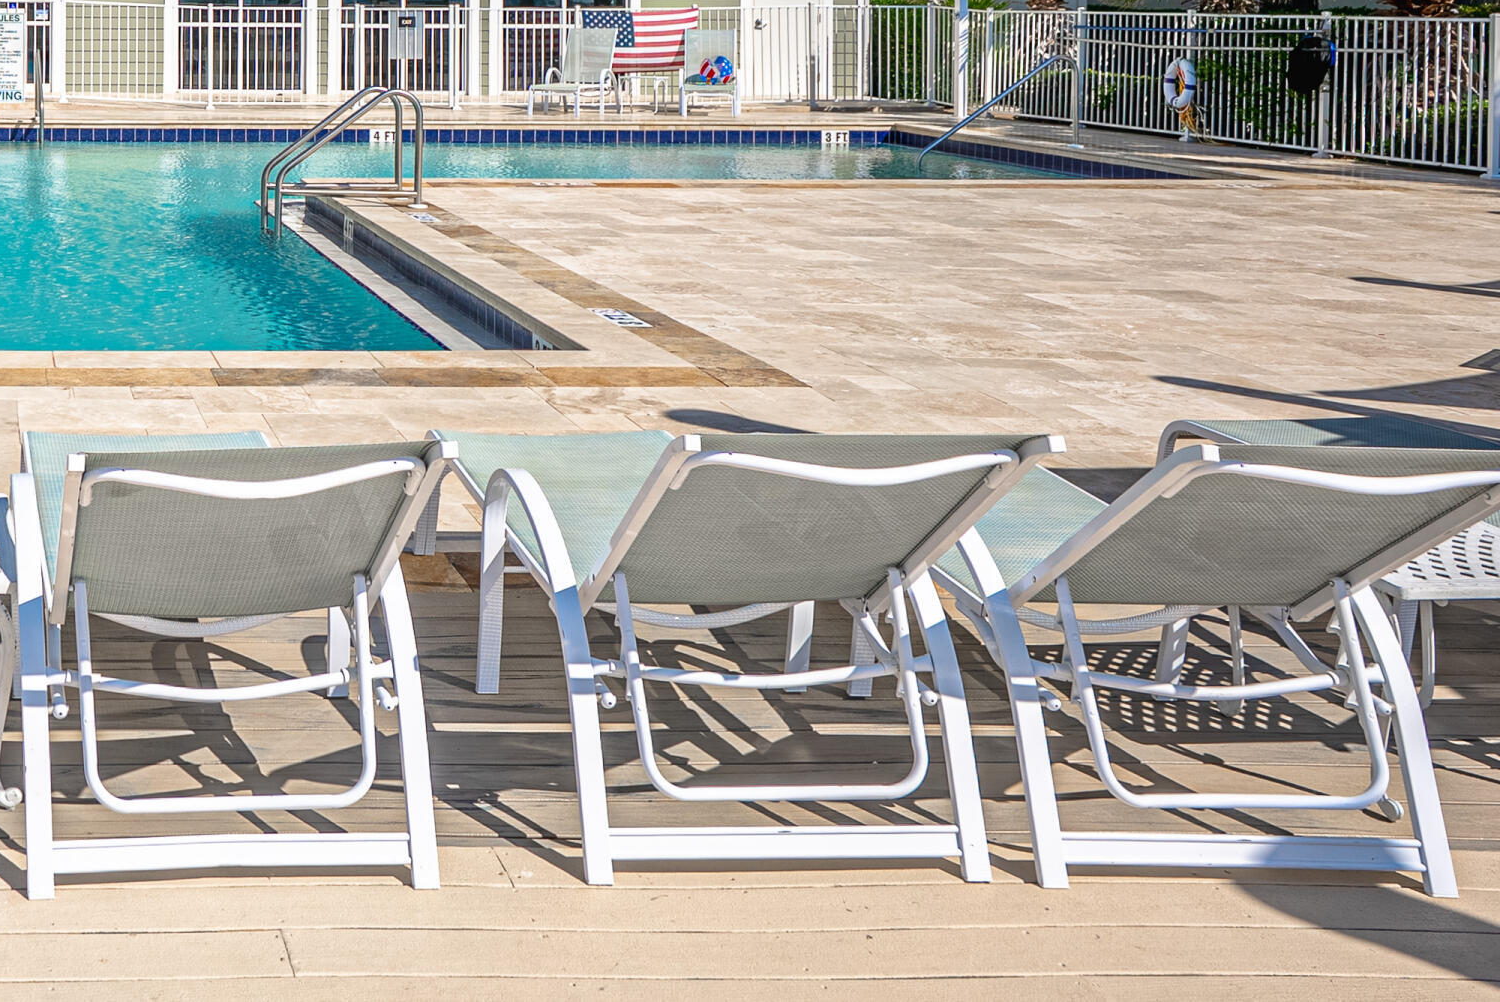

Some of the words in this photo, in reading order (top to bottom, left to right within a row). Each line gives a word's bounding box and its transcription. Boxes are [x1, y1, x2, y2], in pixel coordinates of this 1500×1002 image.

[373, 131, 380, 141] 4
[825, 132, 832, 142] 3
[836, 132, 848, 142] FT
